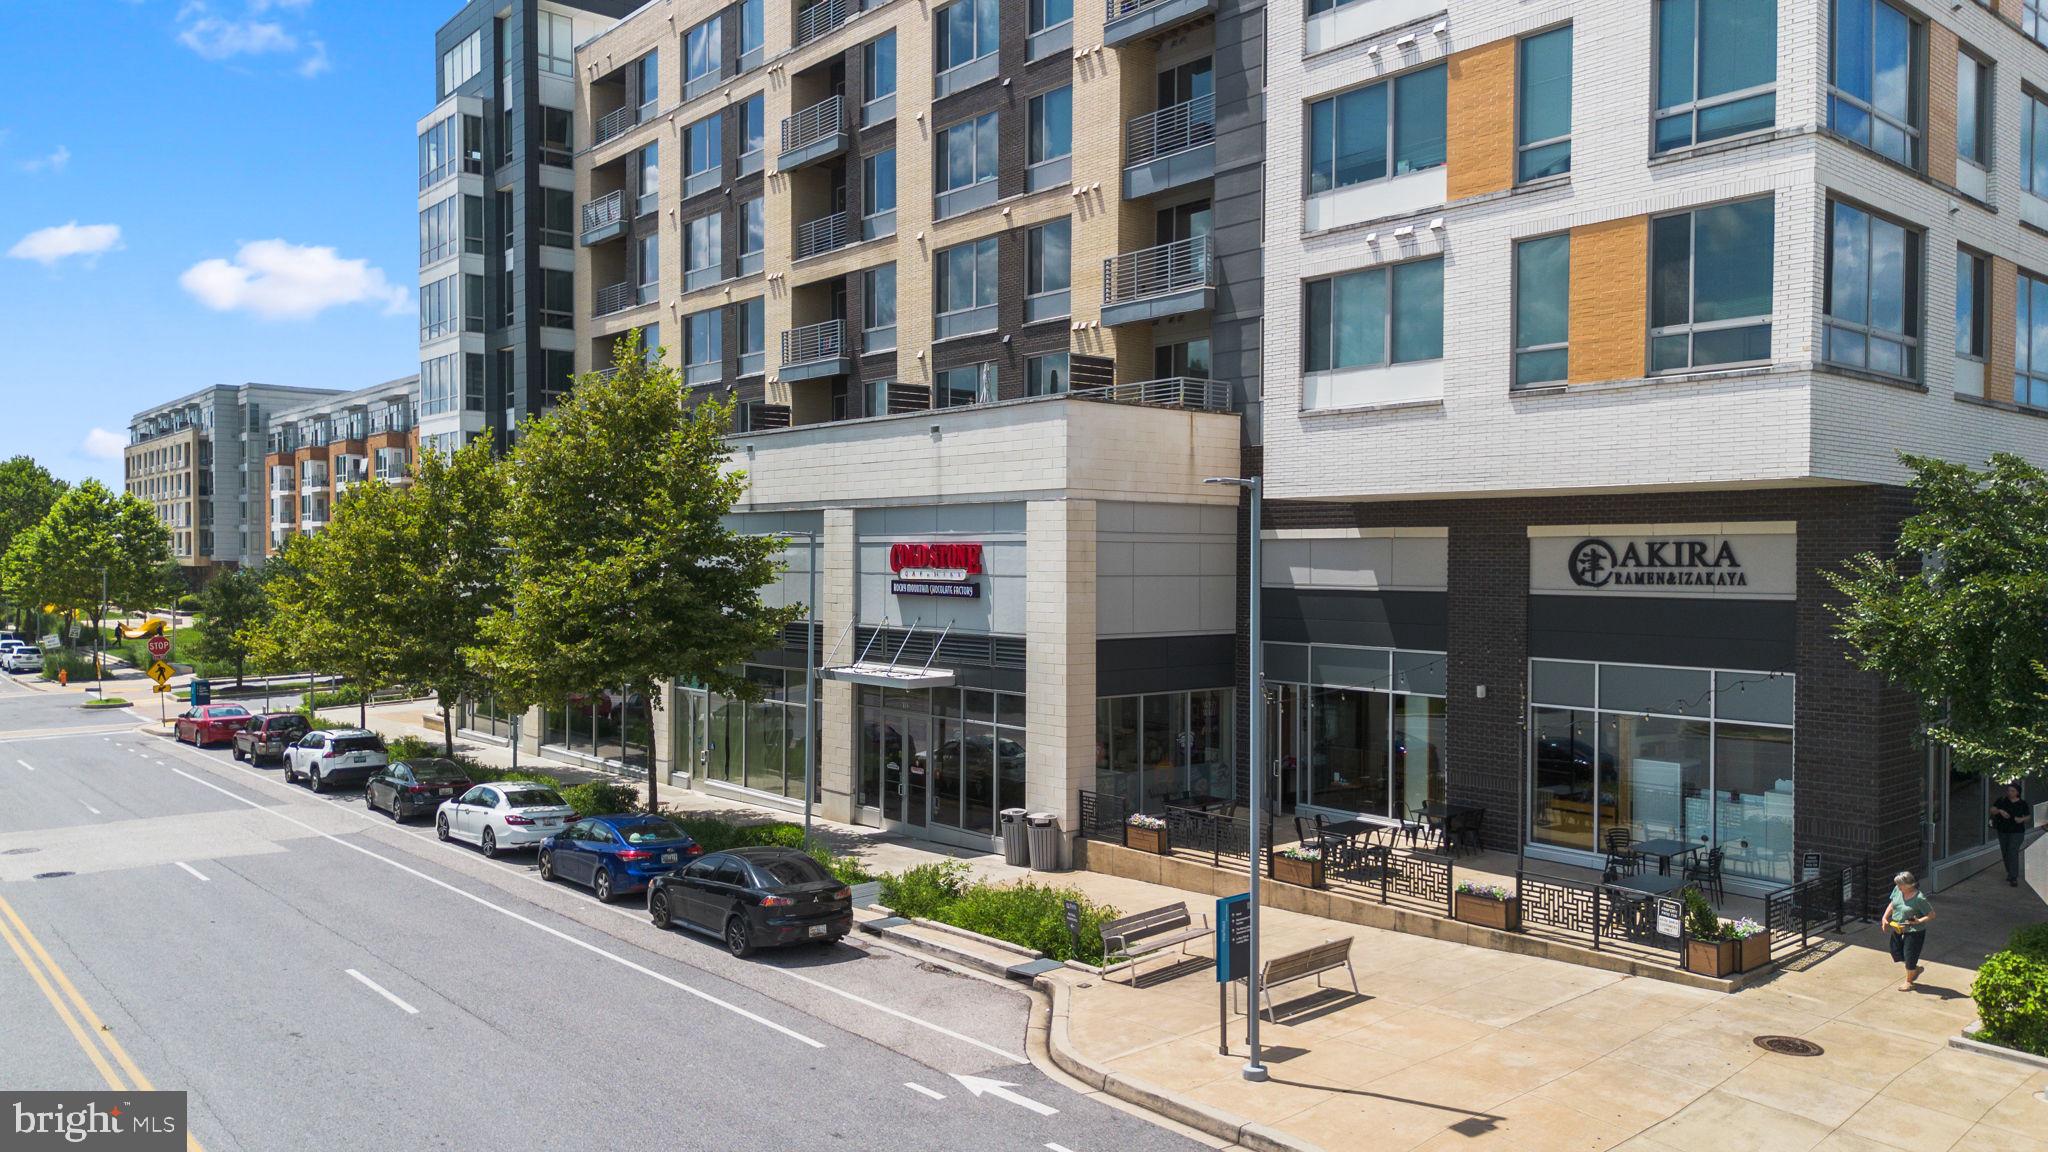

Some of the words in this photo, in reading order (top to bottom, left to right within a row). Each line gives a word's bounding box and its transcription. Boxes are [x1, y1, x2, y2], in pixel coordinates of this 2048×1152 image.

[1619, 540, 1741, 568] AKIRA
[1614, 571, 1748, 586] RAMEN&IZAKAYA
[149, 641, 169, 651] STOP
